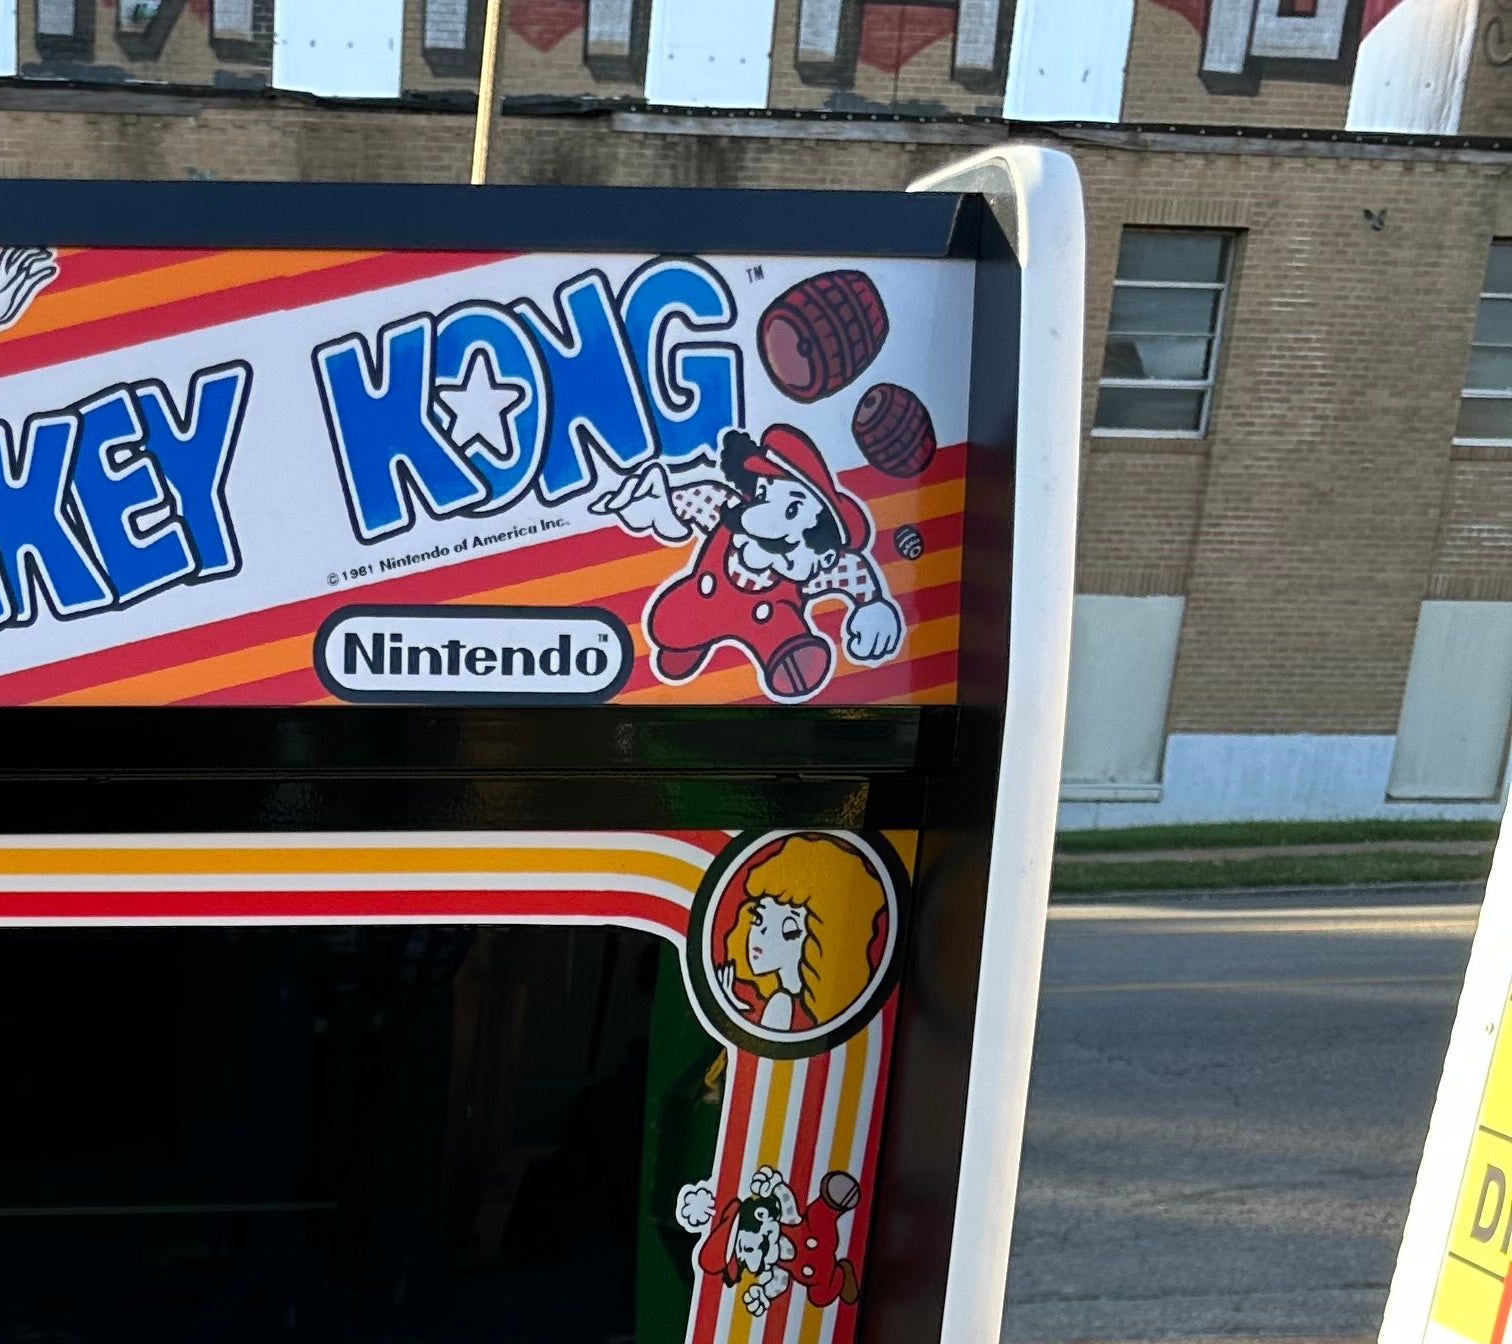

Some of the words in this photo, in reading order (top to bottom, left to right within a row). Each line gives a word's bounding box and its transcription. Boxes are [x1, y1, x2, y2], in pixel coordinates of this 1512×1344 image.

[312, 254, 746, 545] KONG
[379, 545, 451, 572] Nintendo
[453, 537, 469, 554] of
[471, 523, 538, 549] America
[344, 633, 609, 676] Nintendo
